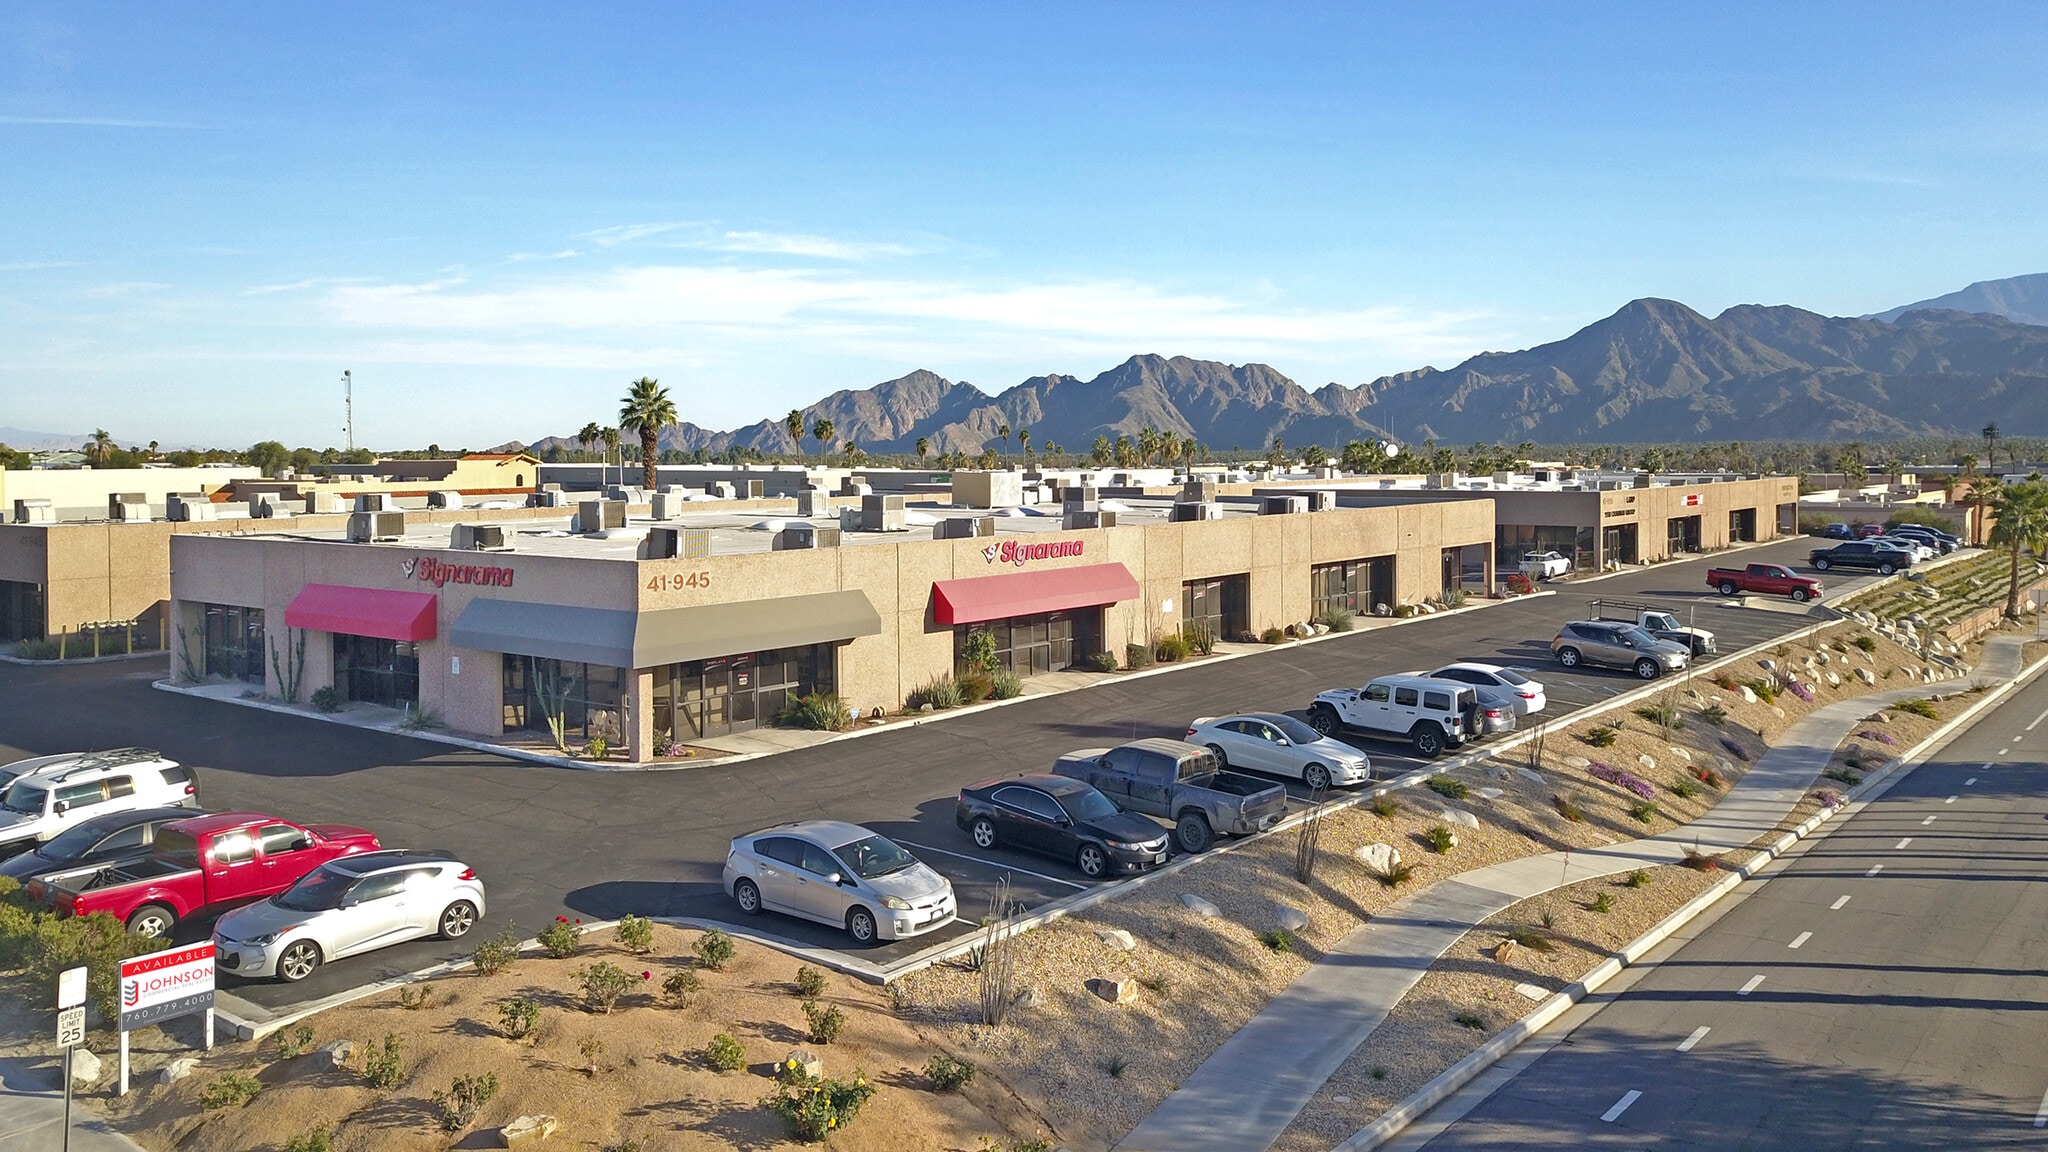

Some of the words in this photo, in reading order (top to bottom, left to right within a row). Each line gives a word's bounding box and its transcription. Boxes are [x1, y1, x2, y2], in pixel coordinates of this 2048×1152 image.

[1000, 540, 1084, 567] Signarama
[419, 557, 514, 588] Signarama
[646, 571, 710, 592] 41-945
[132, 948, 207, 973] AVAILABLE
[142, 965, 213, 993] JOHNSON
[143, 985, 180, 998] COMMERCIAL
[60, 1010, 83, 1022] SPEED
[126, 992, 213, 1022] 760.779.4000
[62, 1018, 80, 1029] LIMIT
[61, 1027, 81, 1044] 25
